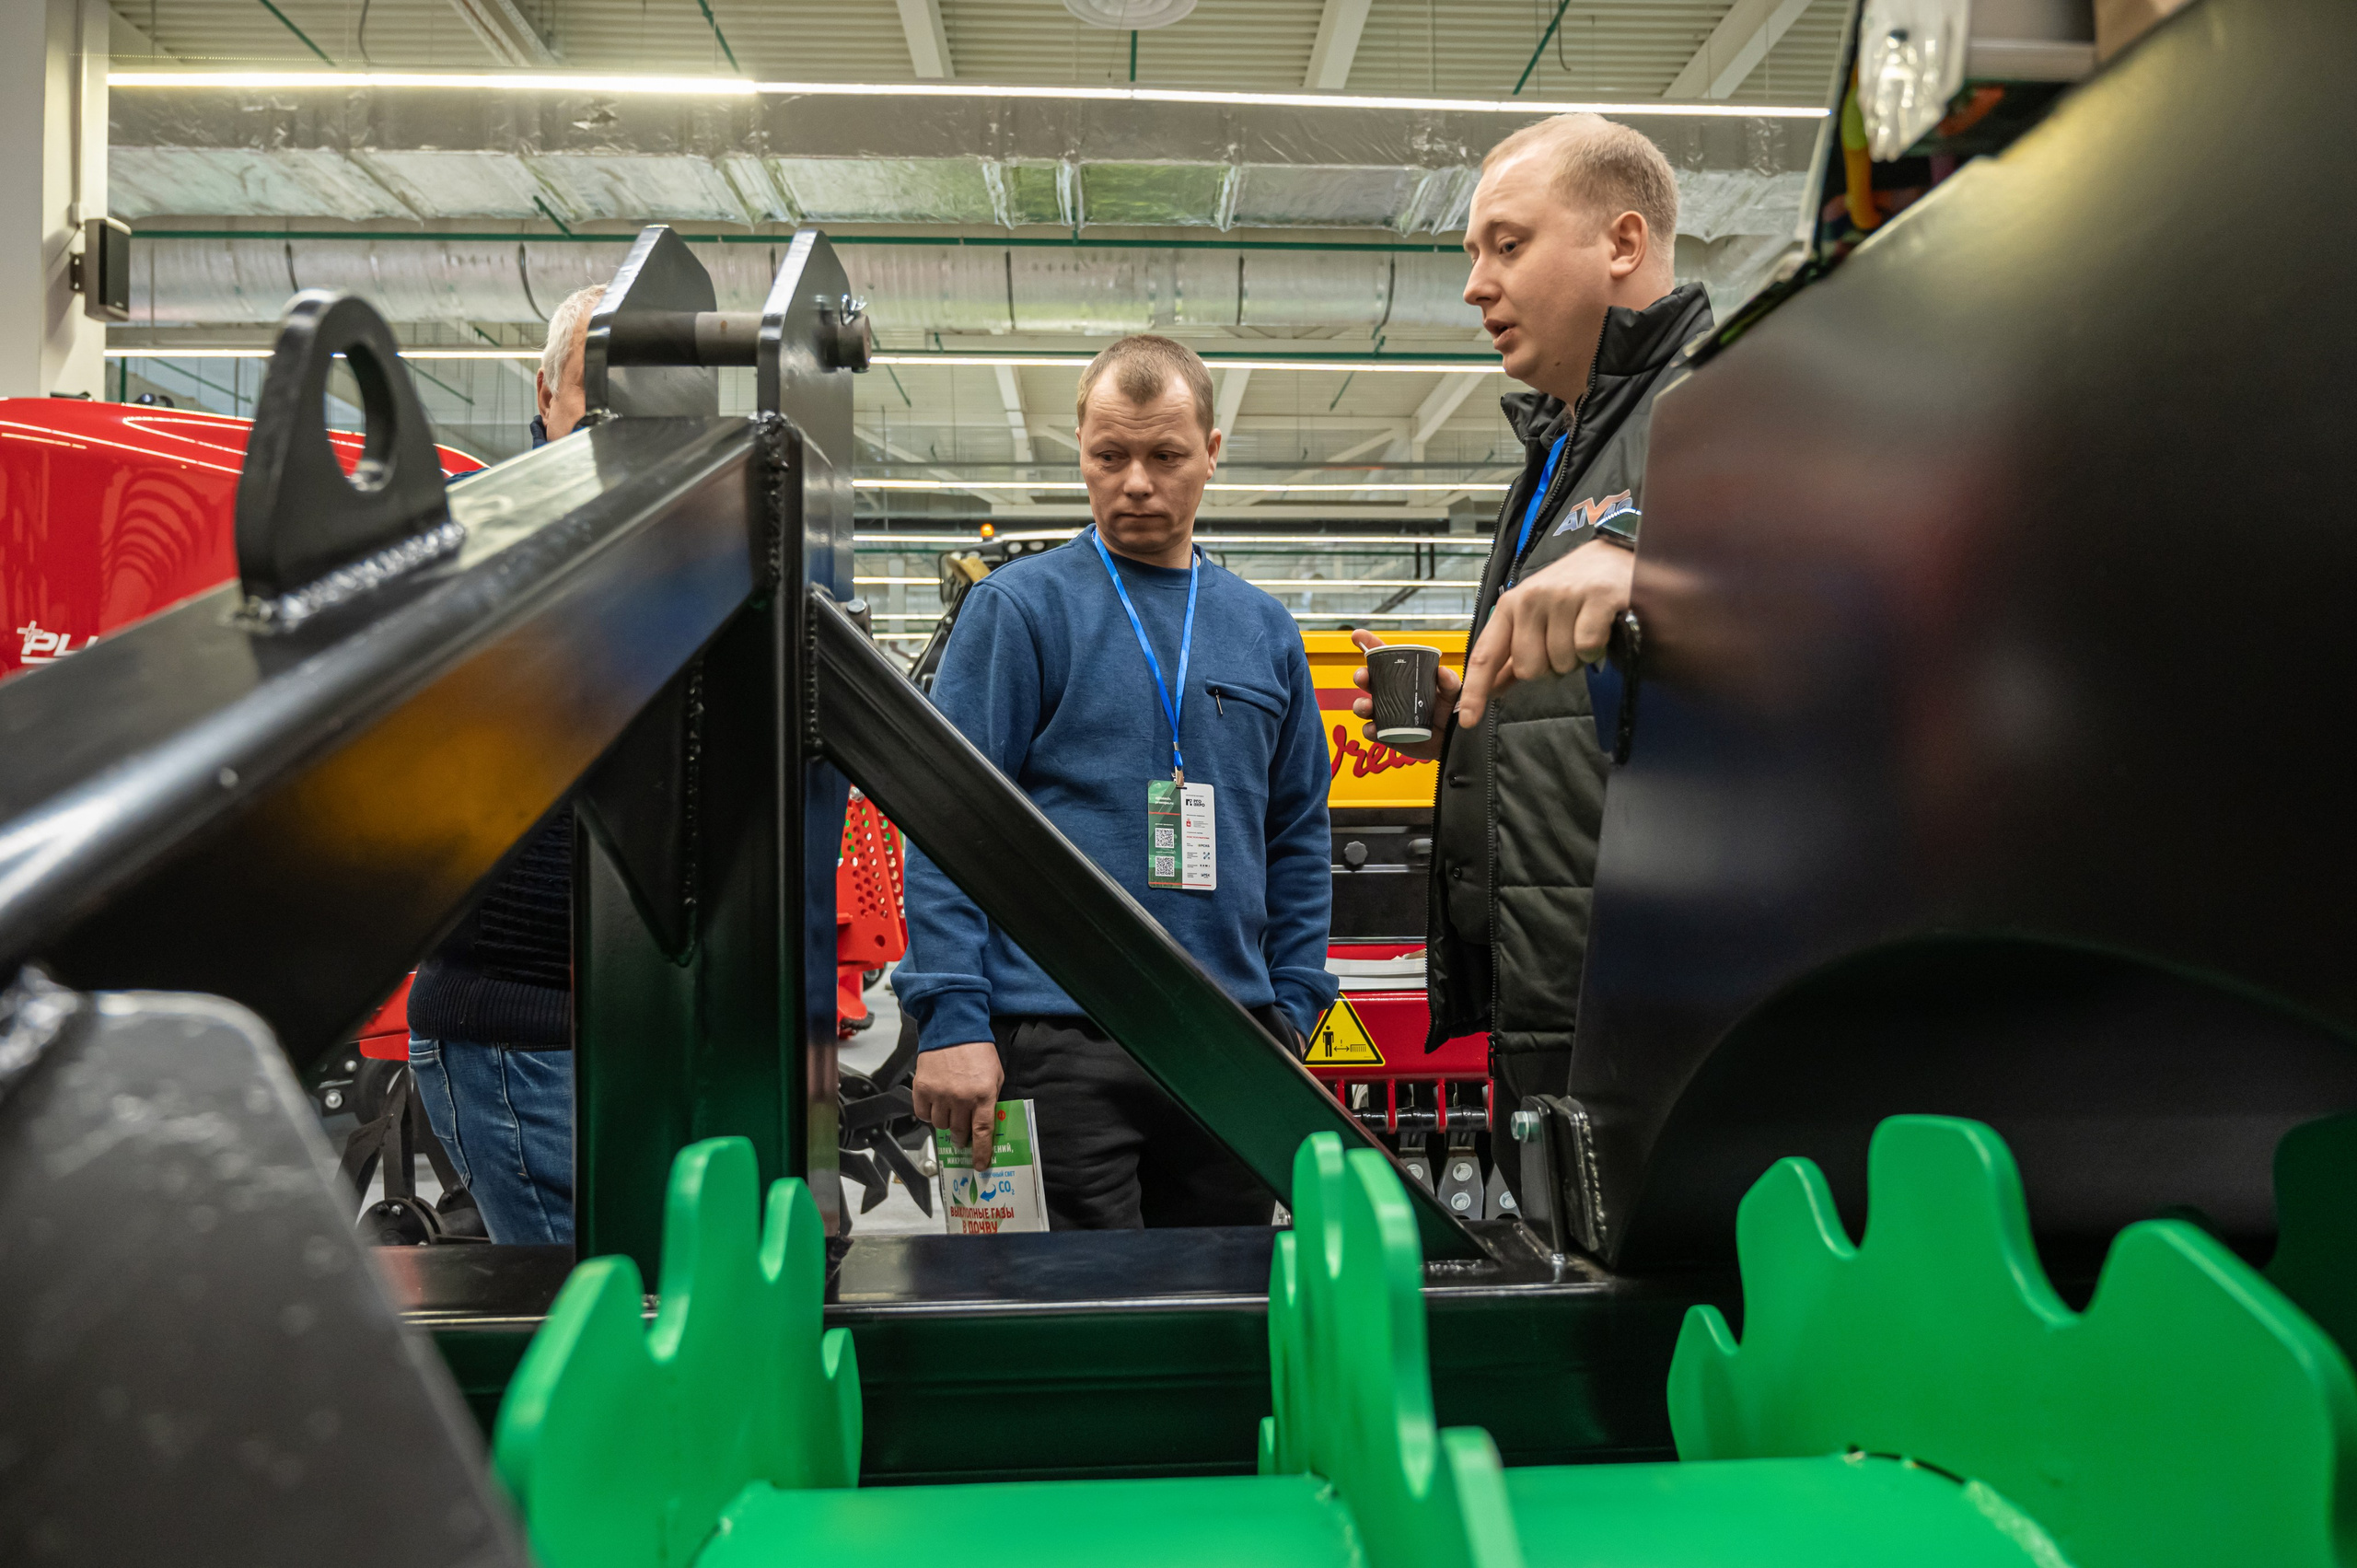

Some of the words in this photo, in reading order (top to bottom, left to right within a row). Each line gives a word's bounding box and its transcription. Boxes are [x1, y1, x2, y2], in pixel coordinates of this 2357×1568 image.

[950, 1206, 990, 1219] ВЫХЛОПНЫЕ
[991, 1207, 1015, 1218] ГАЗЫ
[962, 1221, 968, 1234] В
[968, 1221, 998, 1234] ПОЧВУ
